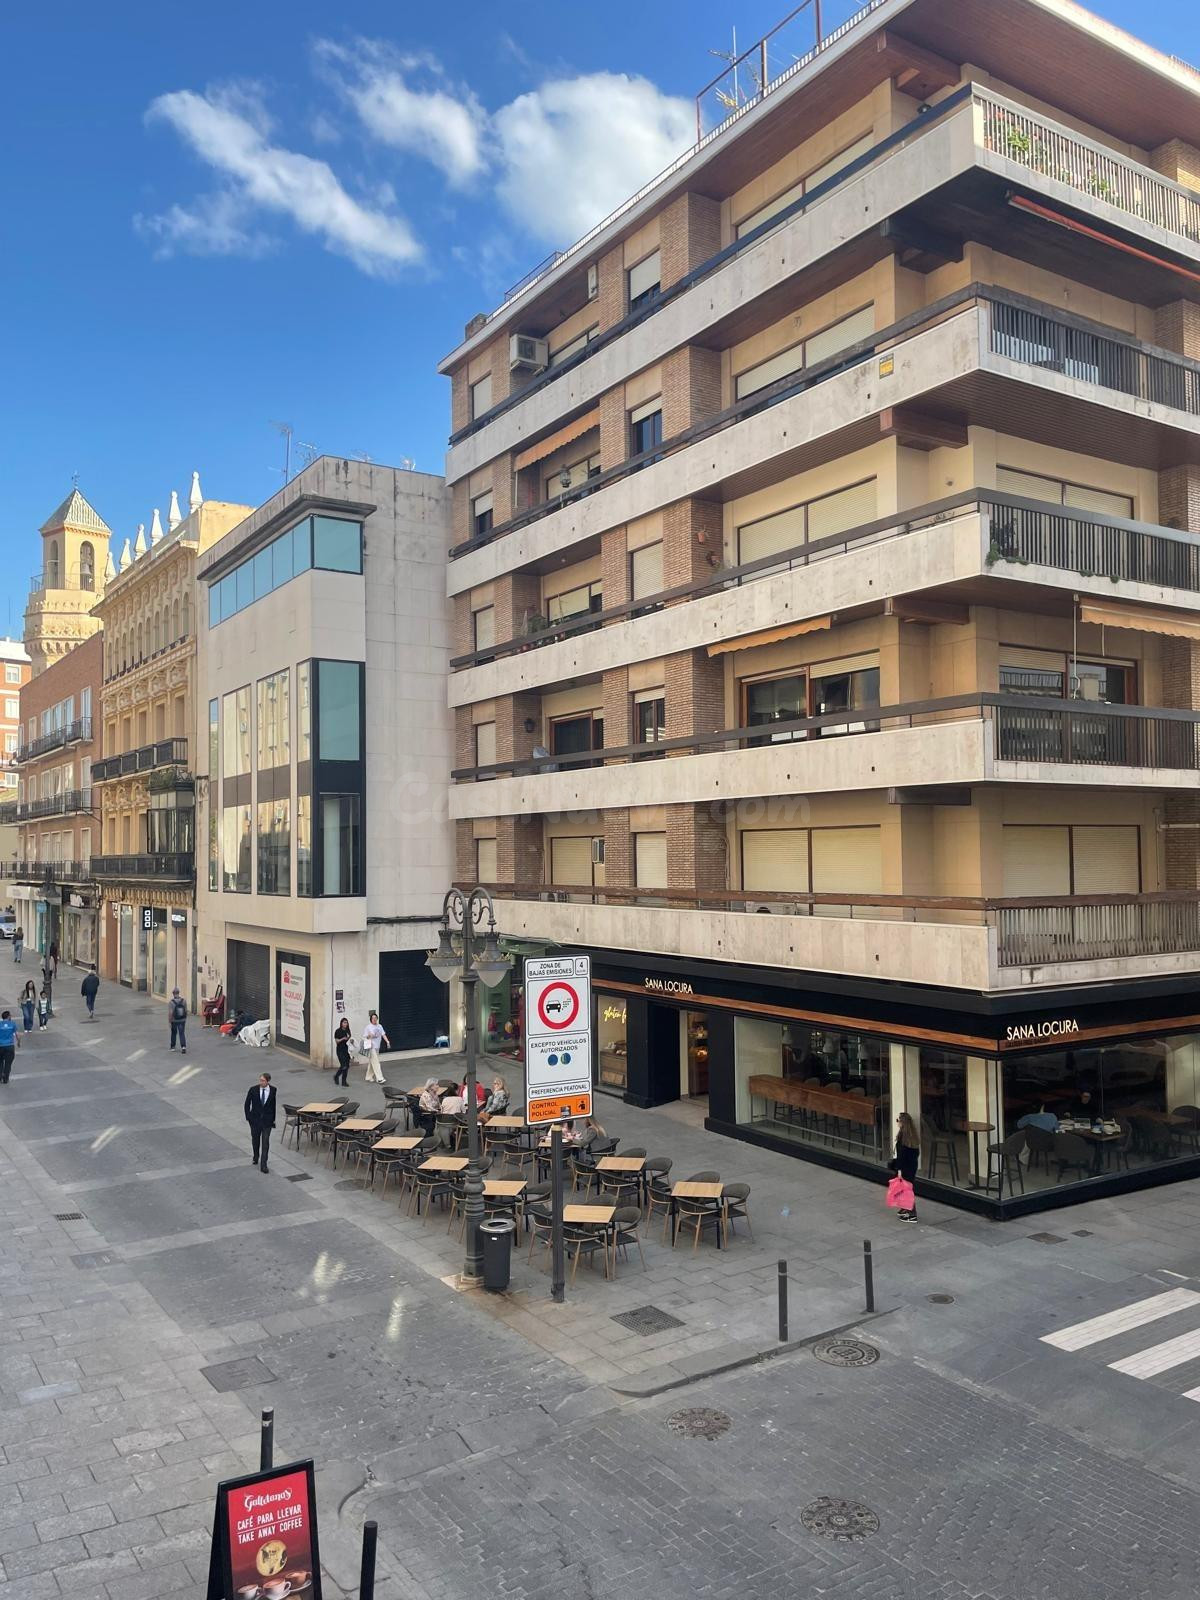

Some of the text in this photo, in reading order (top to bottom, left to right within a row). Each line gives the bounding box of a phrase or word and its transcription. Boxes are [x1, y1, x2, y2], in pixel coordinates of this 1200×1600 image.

[645, 977, 664, 990] SANA
[664, 980, 694, 995] LOCURA
[1006, 1019, 1079, 1041] SANA LOCURA
[540, 1045, 578, 1053] AUTORIZADOS
[531, 1084, 587, 1095] PREFERENCIA PEATONAL
[531, 1101, 559, 1109] CONTROL
[237, 1504, 302, 1531] CAFÉ PARA LLEVAR
[238, 1518, 303, 1545] TAKE AWAY COFFEE
